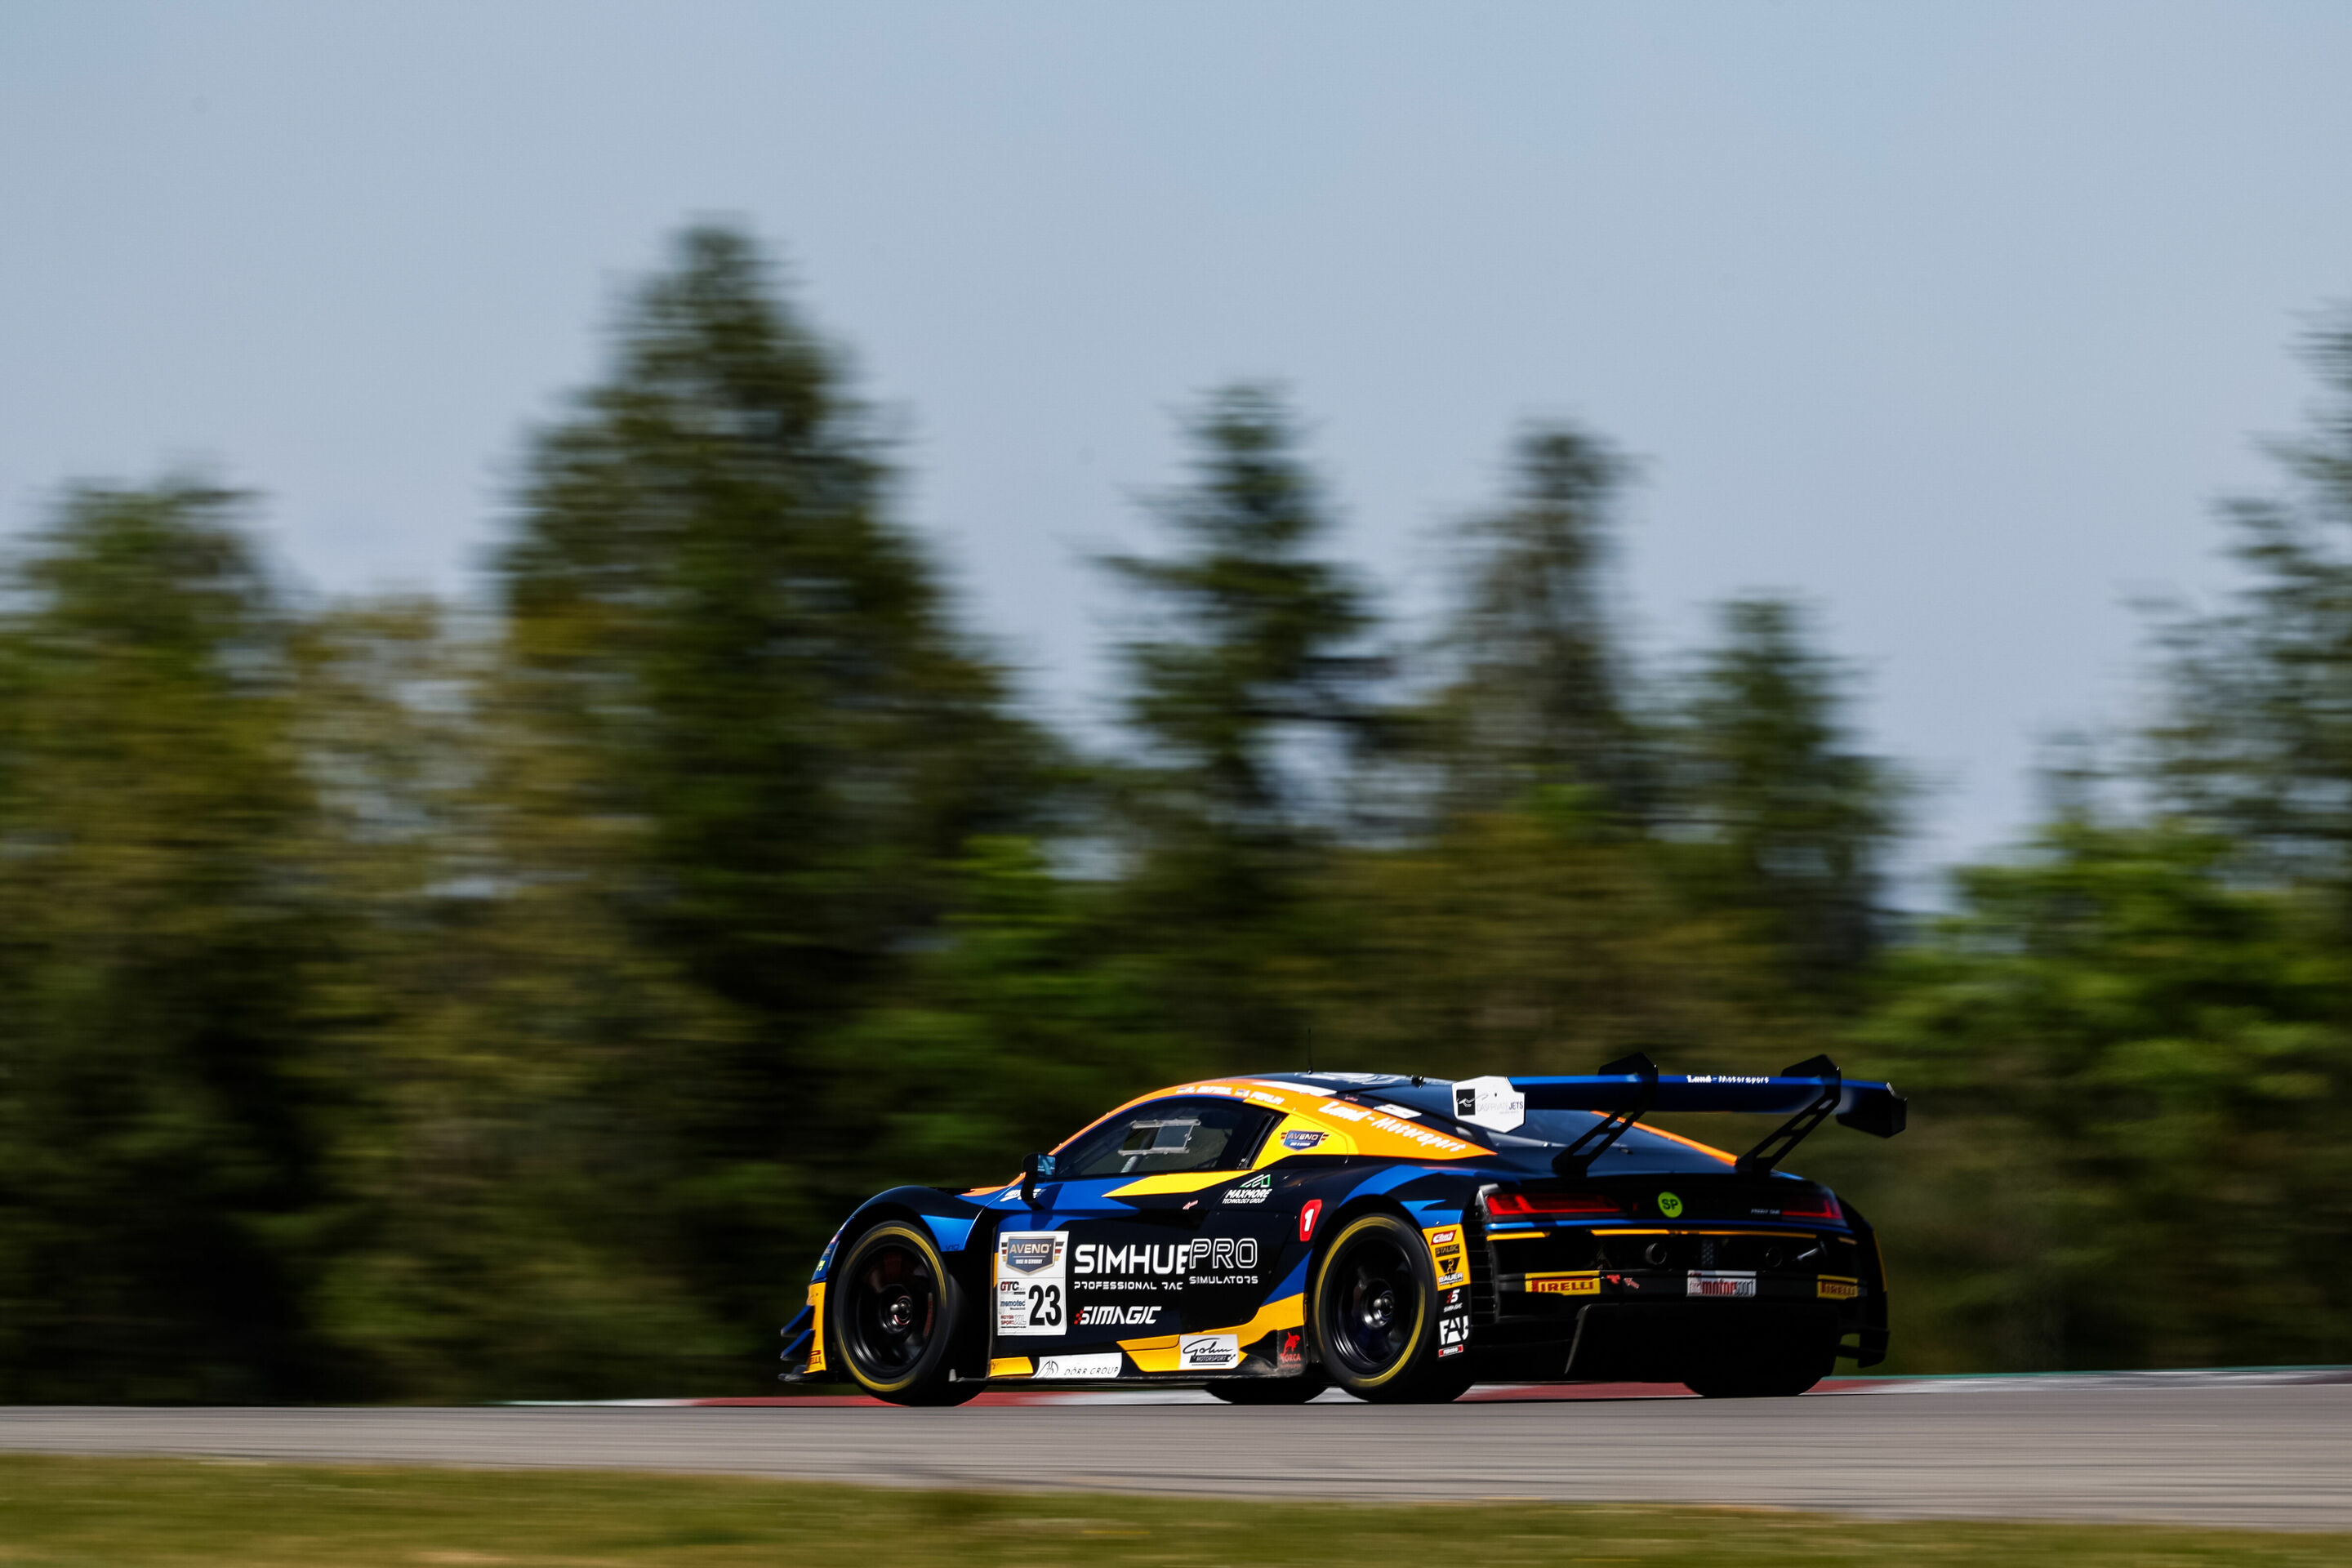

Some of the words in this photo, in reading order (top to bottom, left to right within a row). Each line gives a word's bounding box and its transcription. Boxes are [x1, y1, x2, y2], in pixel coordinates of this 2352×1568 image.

[1318, 1101, 1372, 1121] Land
[1371, 1117, 1466, 1152] Motorsport
[1288, 1133, 1319, 1141] AVENO
[1225, 1189, 1272, 1199] MAXMORE
[1661, 1199, 1678, 1210] SP
[1304, 1209, 1314, 1232] 1
[1009, 1244, 1049, 1254] AVENO
[1189, 1237, 1258, 1269] PRO
[1074, 1281, 1157, 1290] PROFESSIONAL
[1189, 1276, 1258, 1285] SIMULATORS
[1531, 1276, 1593, 1292] PIRELLI
[1000, 1281, 1019, 1291] GTC
[1000, 1299, 1026, 1307] memotec
[1028, 1285, 1062, 1327] 23
[1080, 1306, 1162, 1325] SIMAGIC
[1064, 1367, 1087, 1376] DÖRR
[1089, 1366, 1119, 1375] GROUP
